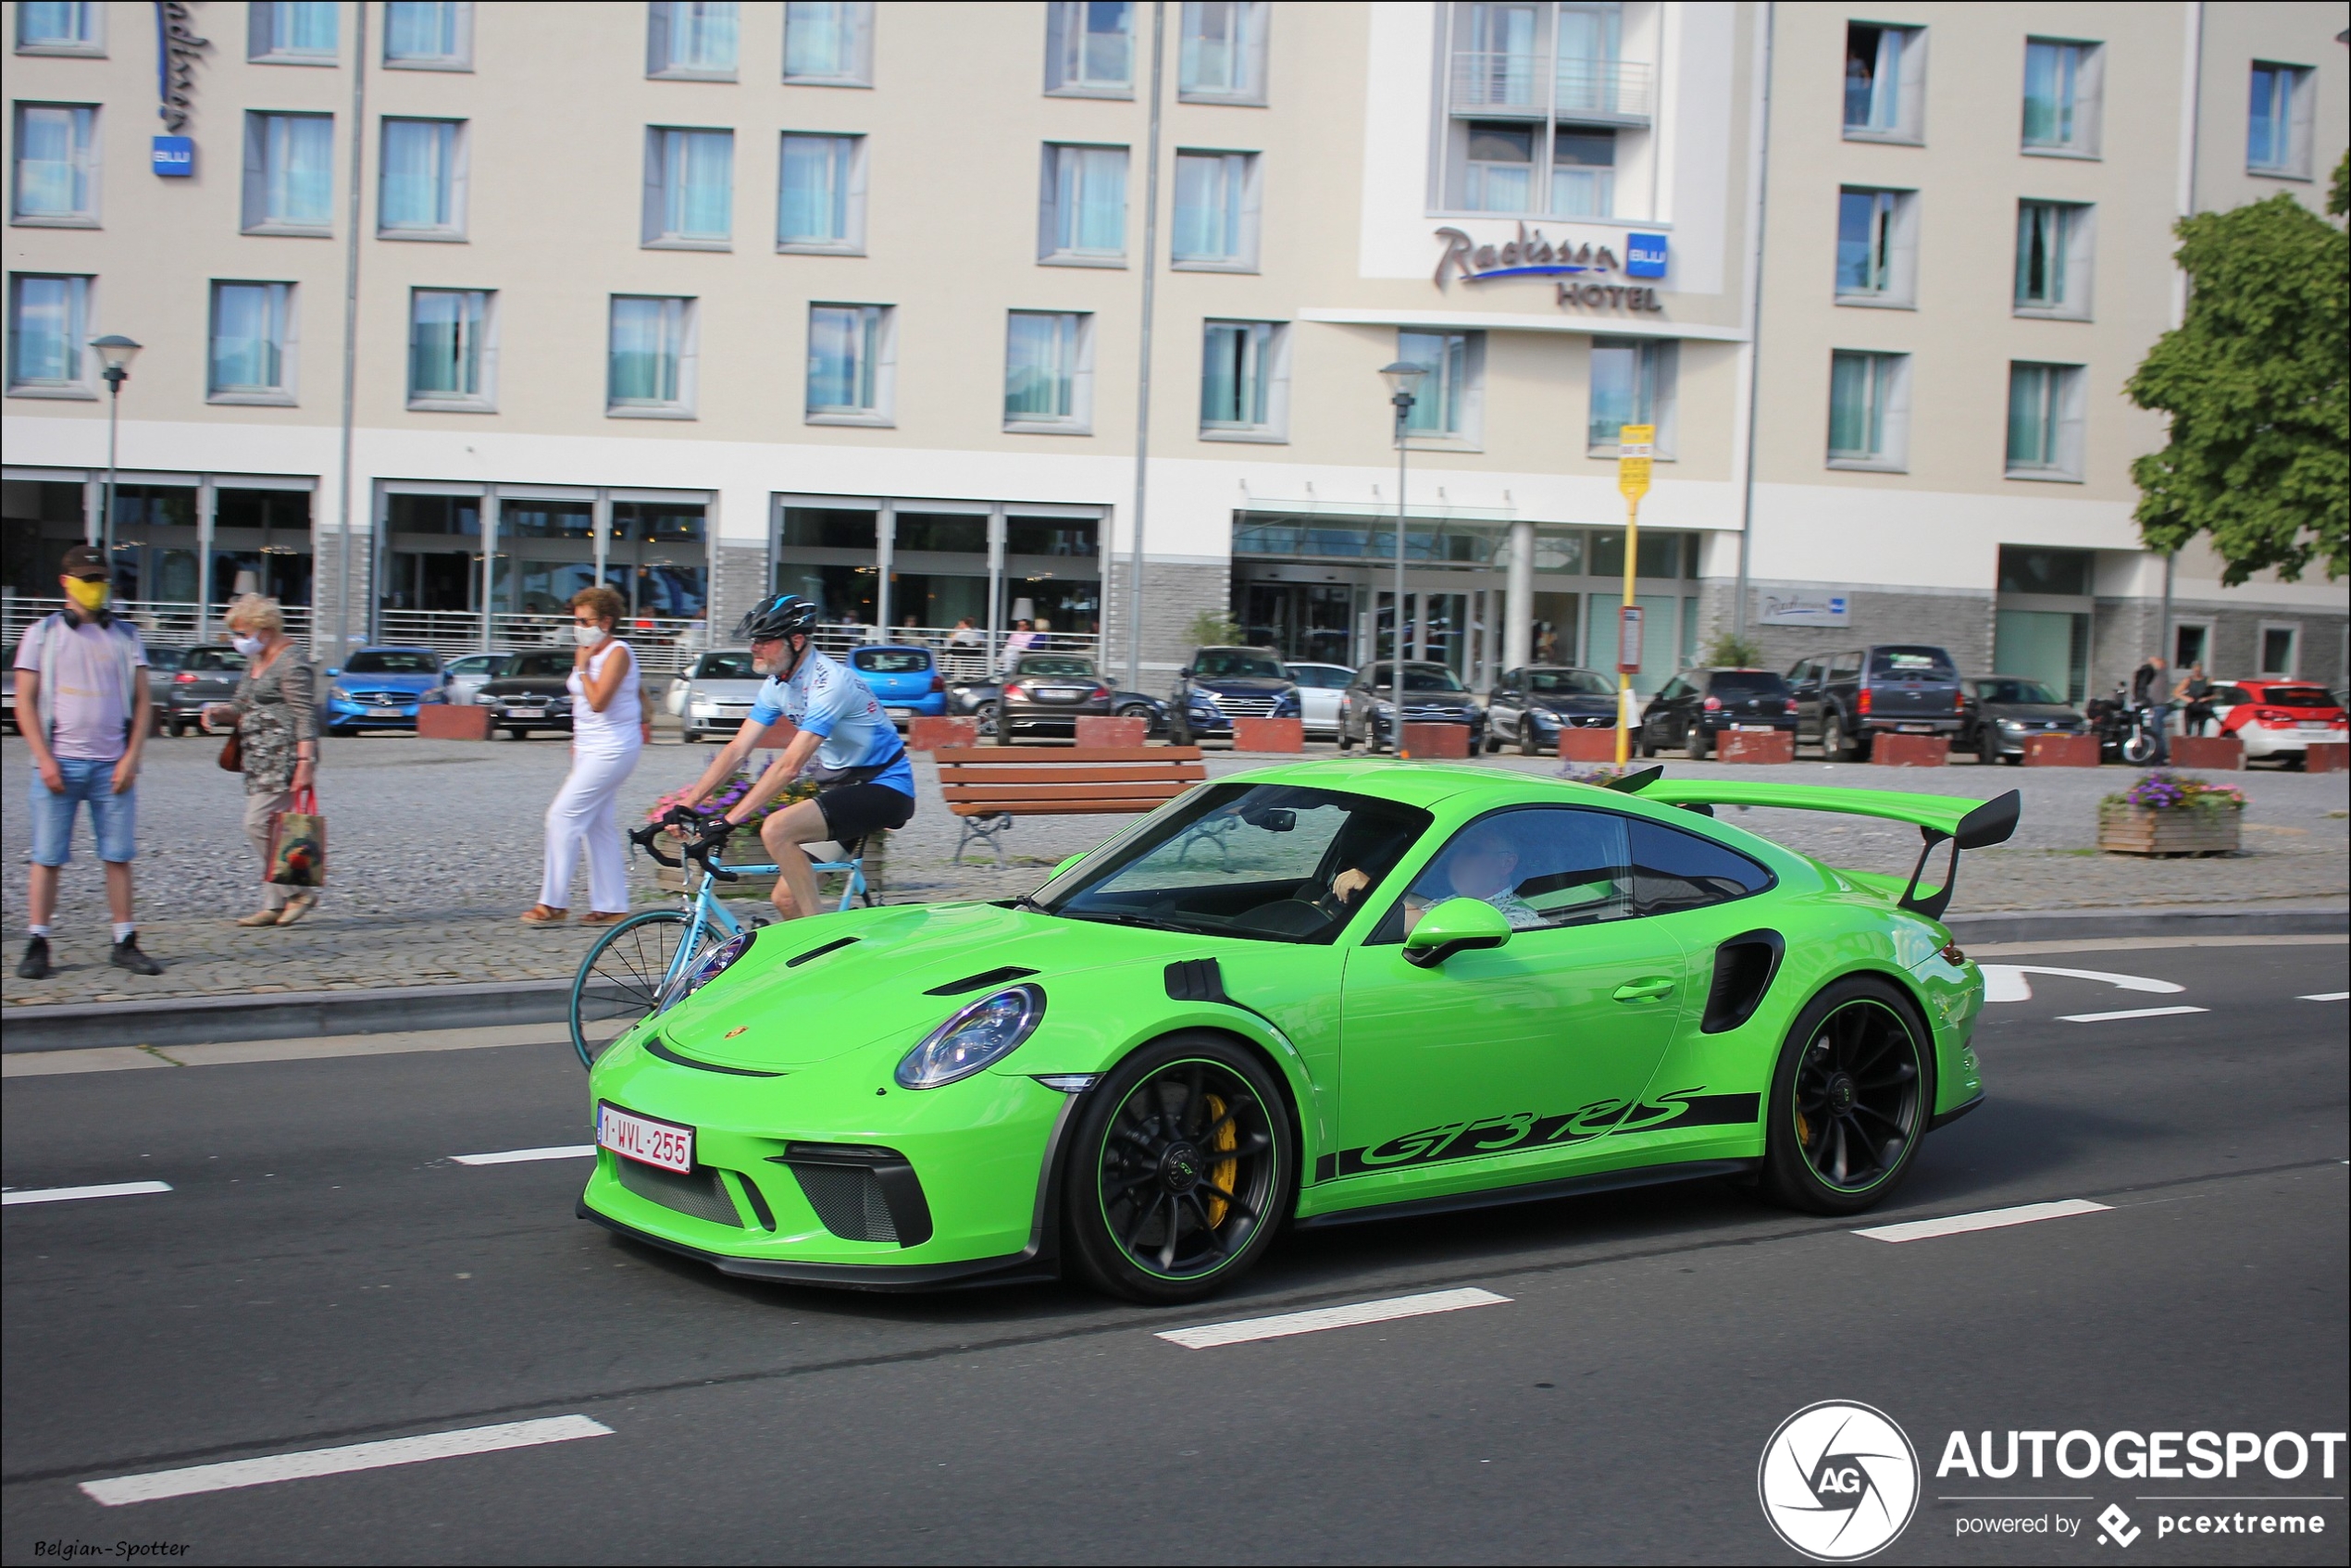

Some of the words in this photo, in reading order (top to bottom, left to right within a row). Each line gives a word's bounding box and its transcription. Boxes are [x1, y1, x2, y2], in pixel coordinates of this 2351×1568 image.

[165, 2, 211, 133] adisson
[1434, 219, 1619, 293] Radisson
[1629, 248, 1665, 264] BLU
[1556, 281, 1662, 312] HOTEL
[604, 1114, 687, 1164] 1-WVL-255
[1361, 1112, 1534, 1165] GT3
[1548, 1085, 1708, 1141] RS
